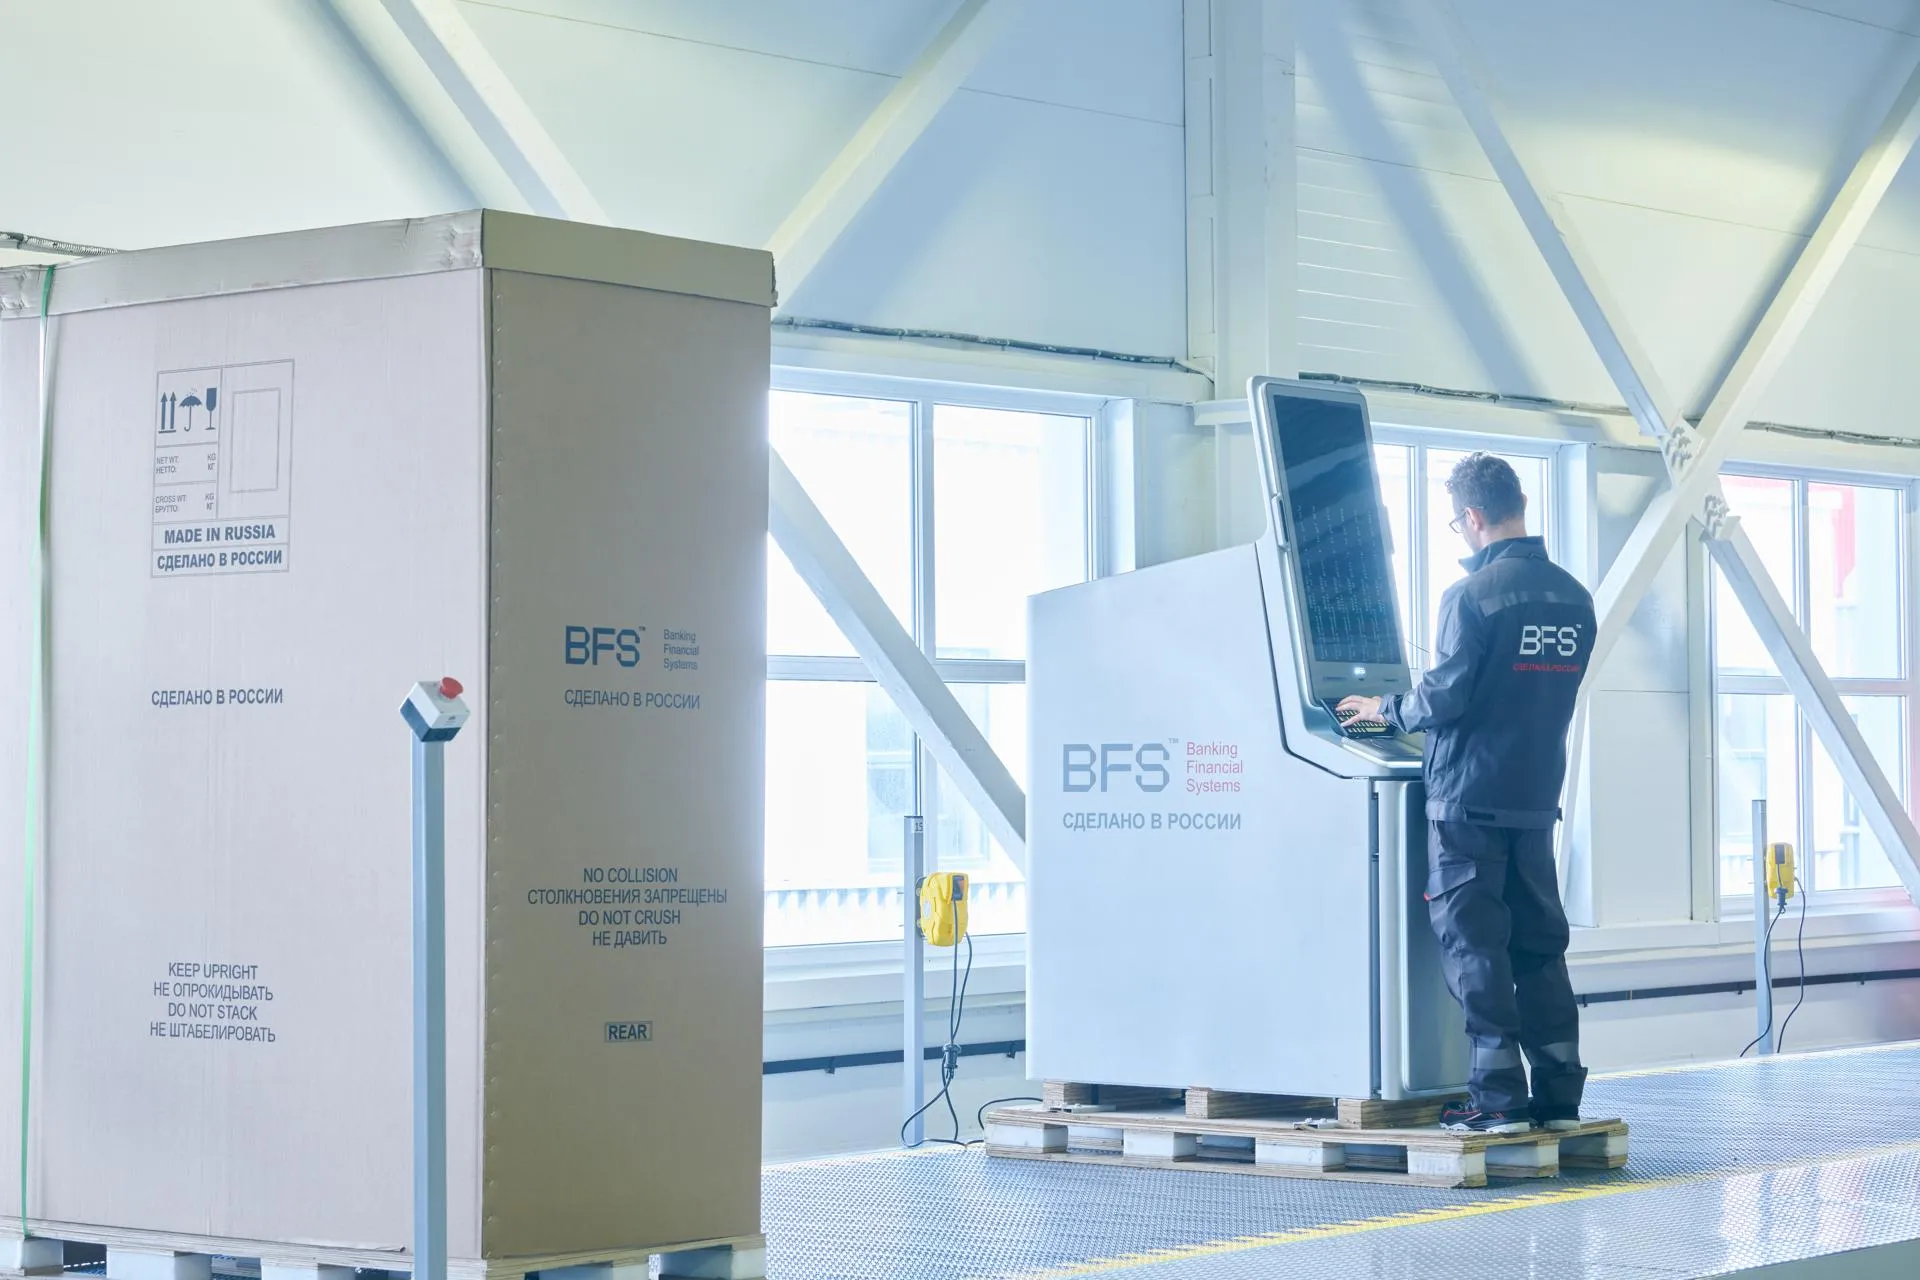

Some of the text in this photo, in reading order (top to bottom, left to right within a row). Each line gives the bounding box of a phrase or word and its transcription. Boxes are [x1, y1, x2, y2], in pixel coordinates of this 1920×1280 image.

[164, 524, 276, 544] MADE IN RUSSIA
[157, 550, 283, 571] СДЕЛАНО В РОССИИ
[663, 629, 697, 644] Banking
[663, 644, 700, 656] Financial
[663, 658, 699, 672] Systems
[151, 688, 283, 708] СДЕЛАНО В РОССИИ
[564, 689, 701, 710] СДЕЛАНО В РОССИИ
[1186, 742, 1238, 758] Banking
[1186, 760, 1243, 774] Financial
[1186, 778, 1241, 796] Systems
[1063, 812, 1241, 832] СДЕЛАНО В РОССИИ
[583, 867, 678, 883] NO COLLISION
[527, 888, 728, 907] СТОЛКНОВЕНИЯ ЗАПРЕЩЕНЫ
[579, 909, 681, 925] DO NOT CRUSH
[592, 930, 668, 948] НЕ ДАВИТЬ
[168, 962, 258, 980] KEEP UPRIGHT
[154, 981, 274, 1002] НЕ ОПРОКИДЫВАТЬ
[168, 1002, 258, 1020] DO NOT STACK
[150, 1021, 276, 1043] НЕ ШТАБЕЛИРОВАТЬ
[608, 1024, 648, 1040] REAR
